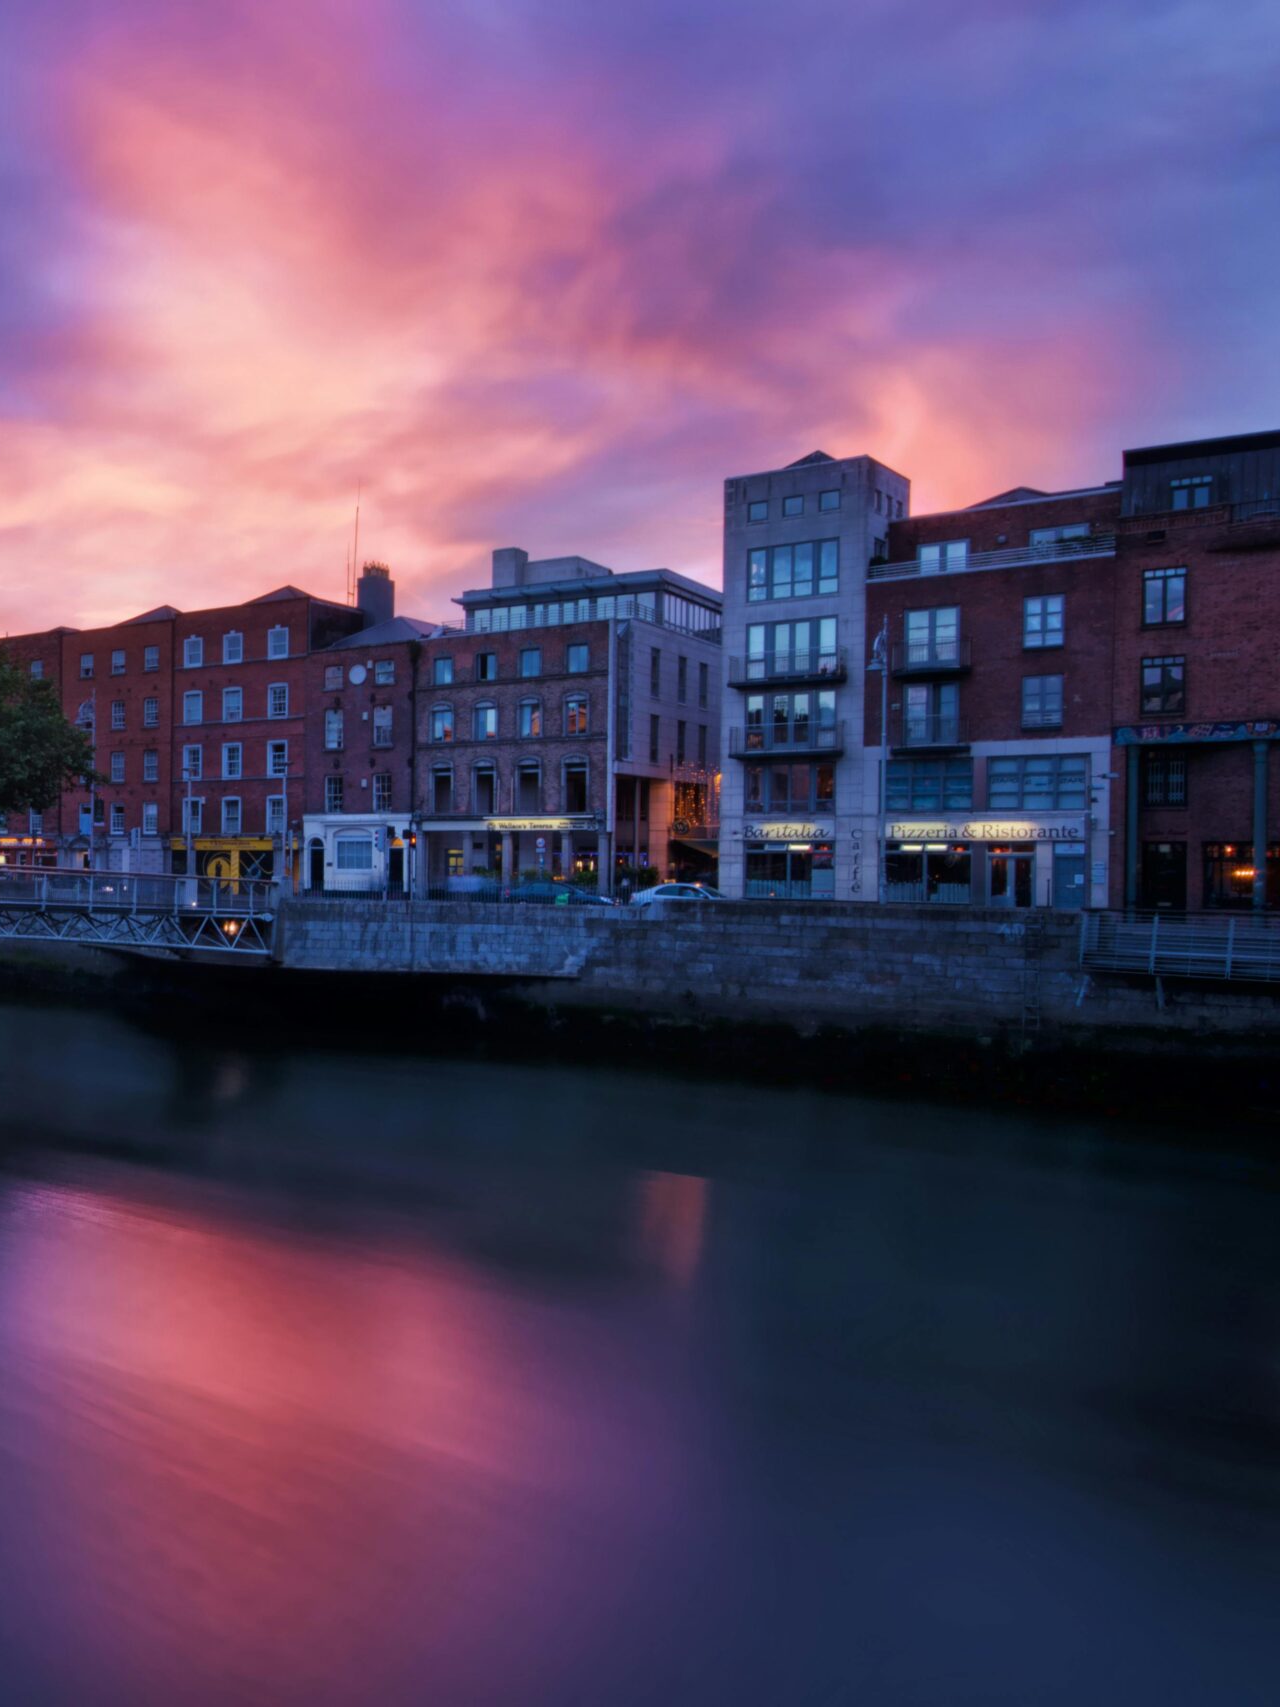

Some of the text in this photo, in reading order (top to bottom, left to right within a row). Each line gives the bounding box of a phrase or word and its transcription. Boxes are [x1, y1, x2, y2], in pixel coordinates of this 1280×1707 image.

[890, 824, 1079, 839] Pizzeria & Ristorante
